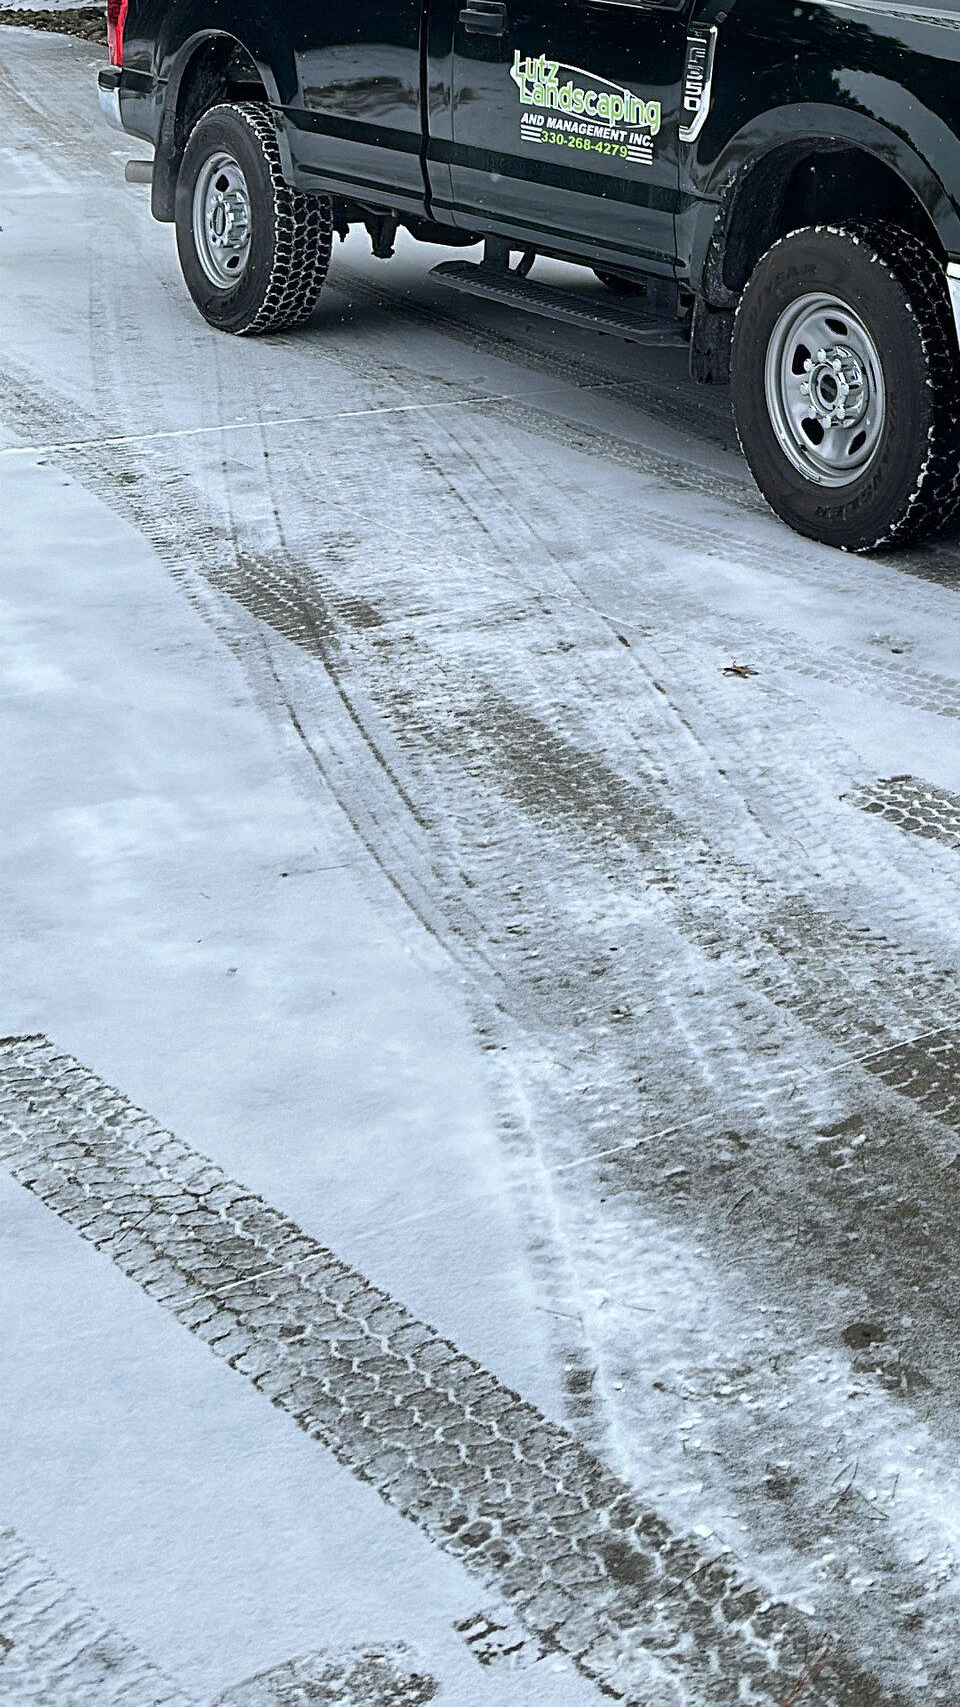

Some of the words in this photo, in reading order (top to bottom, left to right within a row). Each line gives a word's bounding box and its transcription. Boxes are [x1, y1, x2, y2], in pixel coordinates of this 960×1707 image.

[514, 49, 560, 87] Lutz
[519, 76, 662, 136] Landscaping
[520, 112, 545, 127] AND
[546, 117, 628, 143] MANAGEMENT
[628, 132, 655, 148] INC.
[540, 130, 629, 159] 330-268-4279
